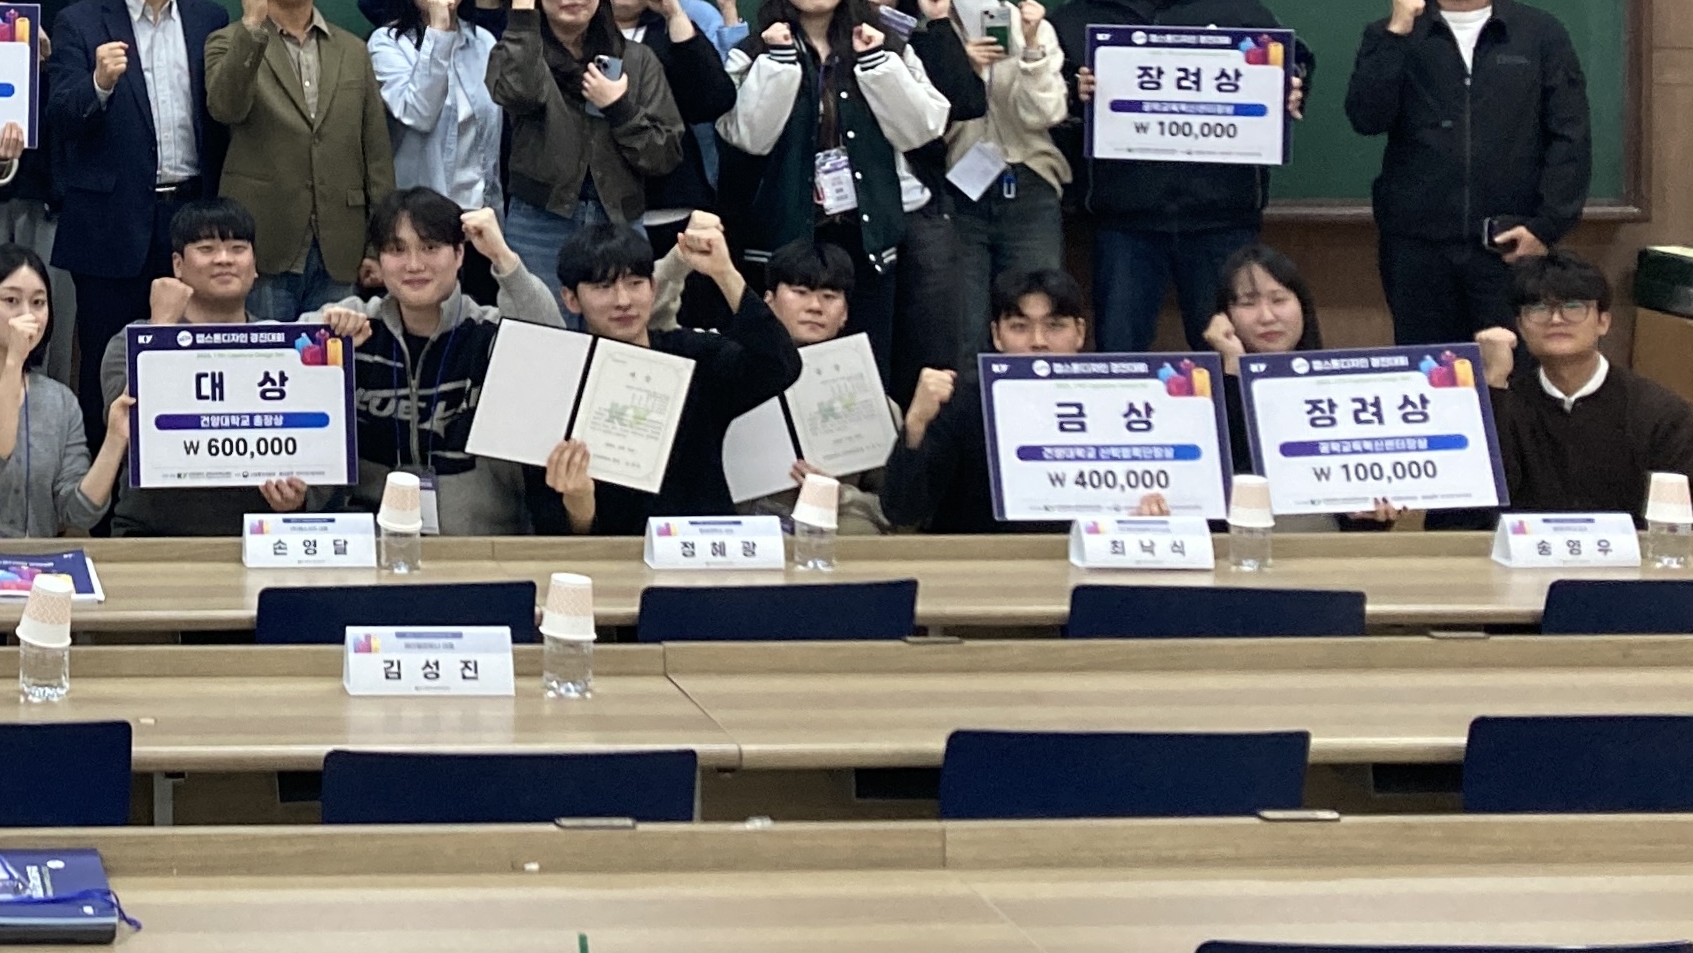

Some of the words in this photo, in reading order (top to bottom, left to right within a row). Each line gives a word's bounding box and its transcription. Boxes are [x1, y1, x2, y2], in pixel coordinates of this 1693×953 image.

[1158, 121, 1238, 139] 100,000
[207, 437, 298, 459] 600,000
[1074, 470, 1170, 492] 400,000
[1340, 460, 1438, 483] 100,000
